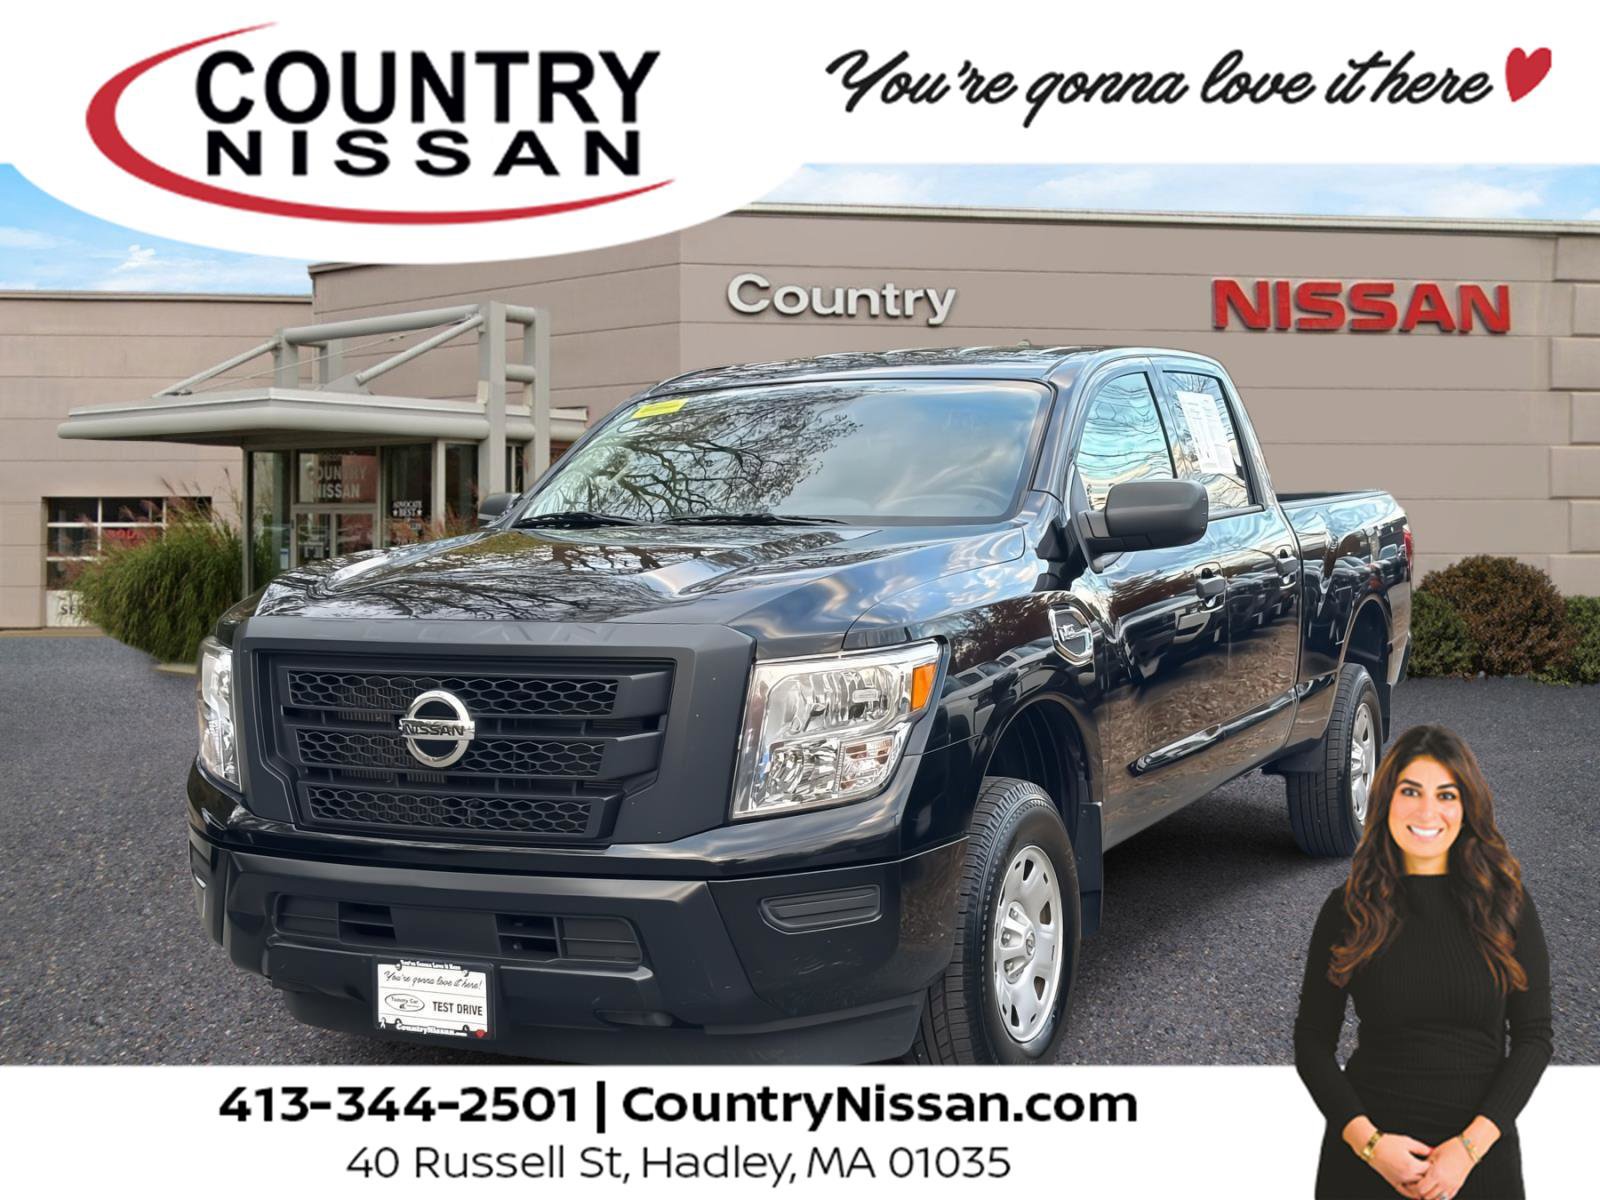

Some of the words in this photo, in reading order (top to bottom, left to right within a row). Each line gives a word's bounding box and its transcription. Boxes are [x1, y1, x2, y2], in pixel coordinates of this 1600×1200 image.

[726, 272, 956, 326] Country
[1212, 279, 1510, 335] NISSAN
[403, 723, 465, 736] NISSAN
[432, 1001, 454, 1013] TEST
[457, 1003, 483, 1016] DRIVE
